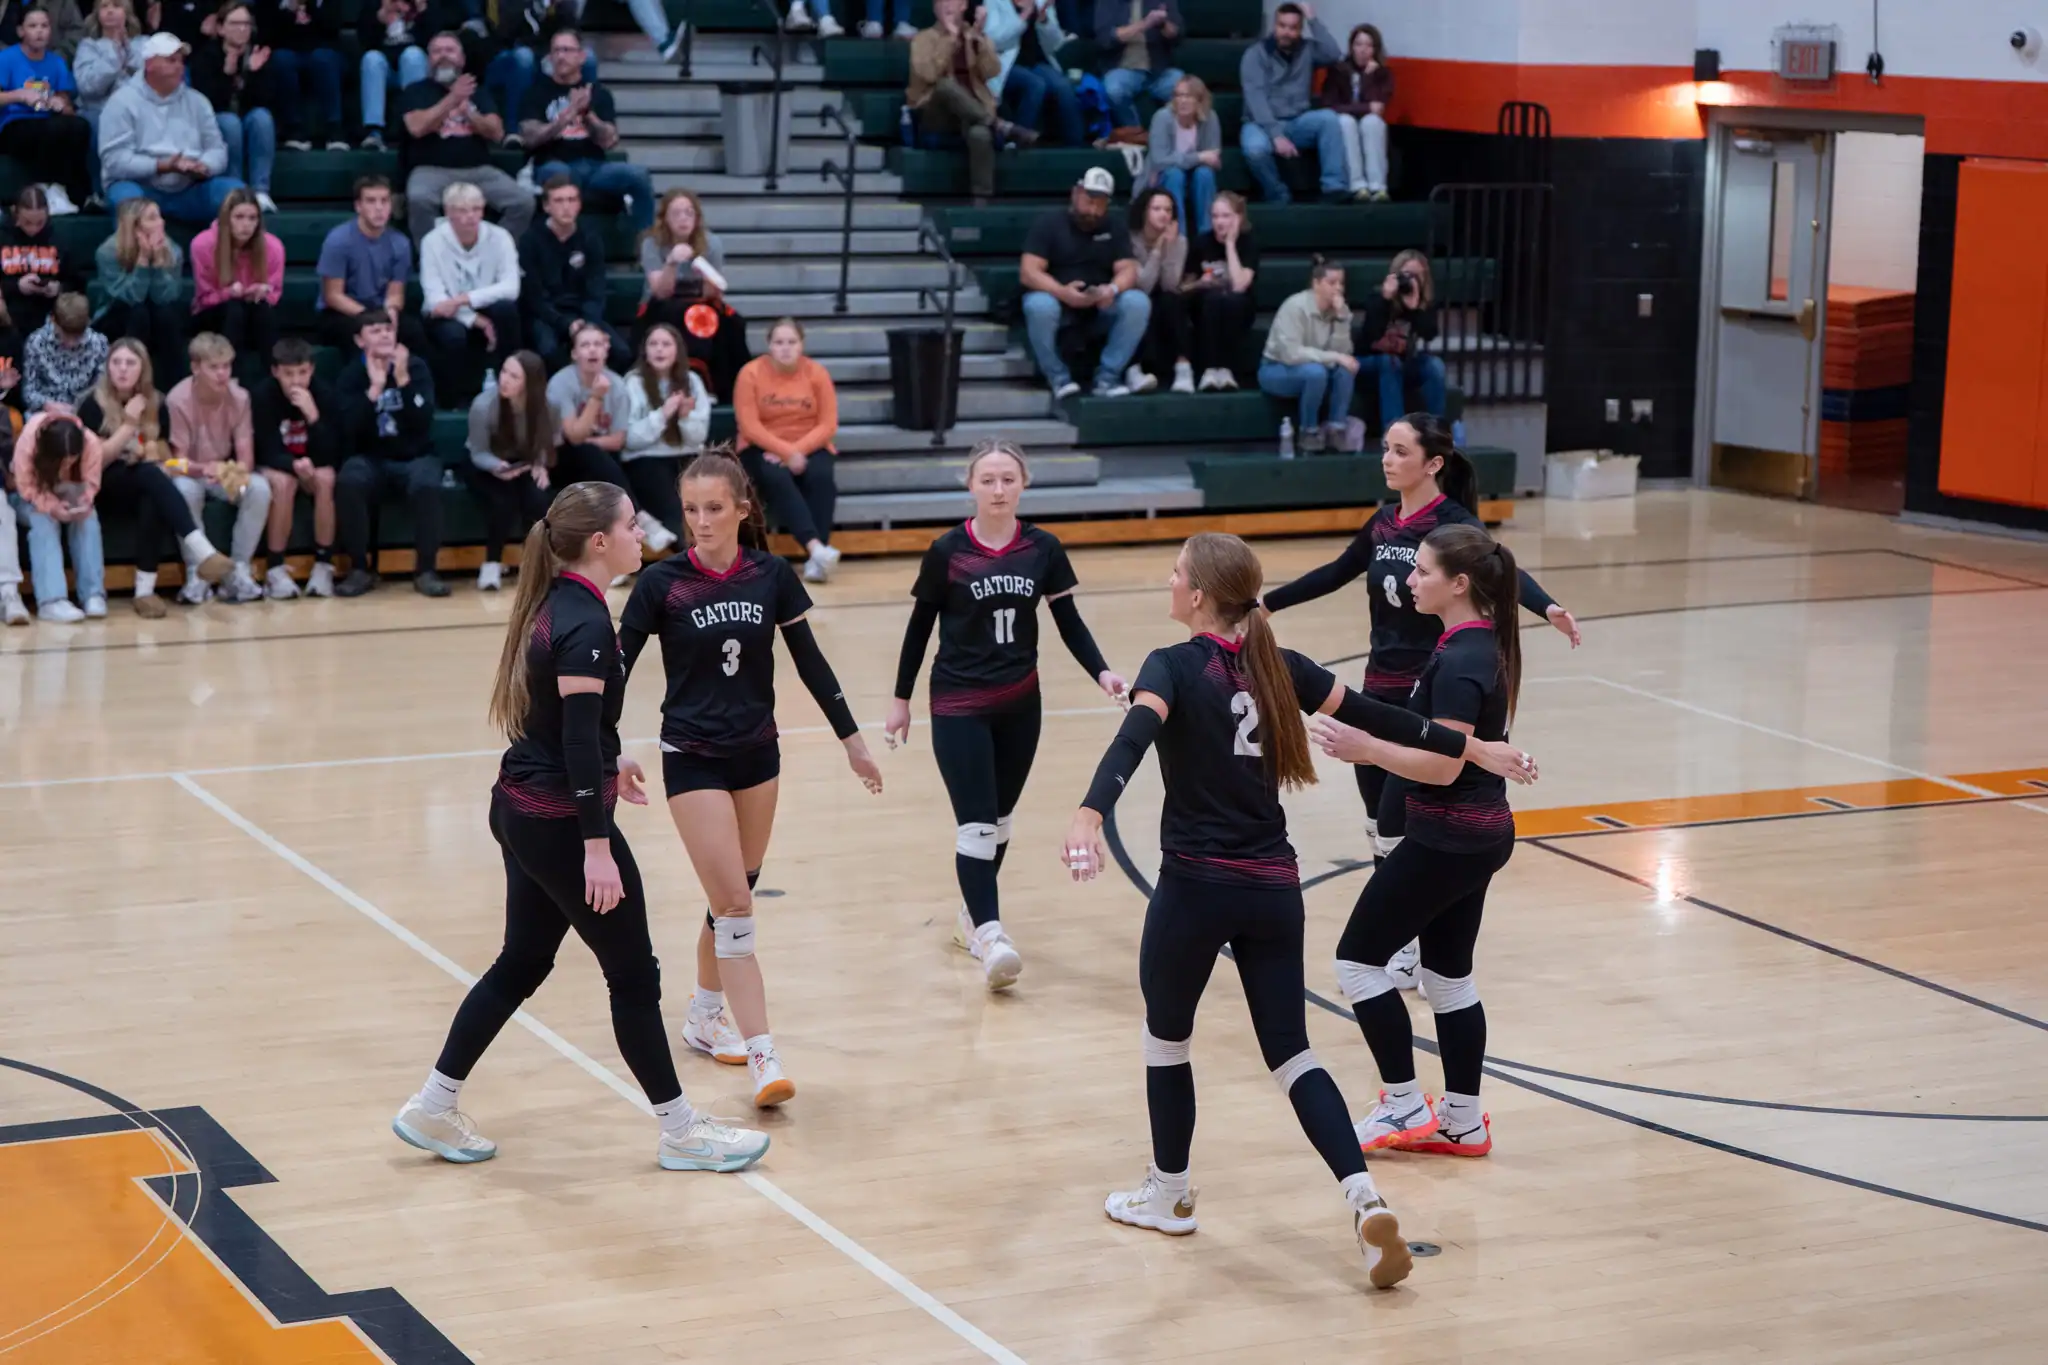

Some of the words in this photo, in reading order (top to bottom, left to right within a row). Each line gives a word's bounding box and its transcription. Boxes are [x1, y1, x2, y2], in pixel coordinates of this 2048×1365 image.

[1787, 43, 1821, 73] EXIT
[970, 575, 1035, 600] GATORS
[1383, 574, 1402, 608] 8
[691, 601, 763, 629] GATORS
[993, 608, 1016, 644] 11
[721, 638, 742, 676] 3
[1230, 691, 1263, 757] 2
